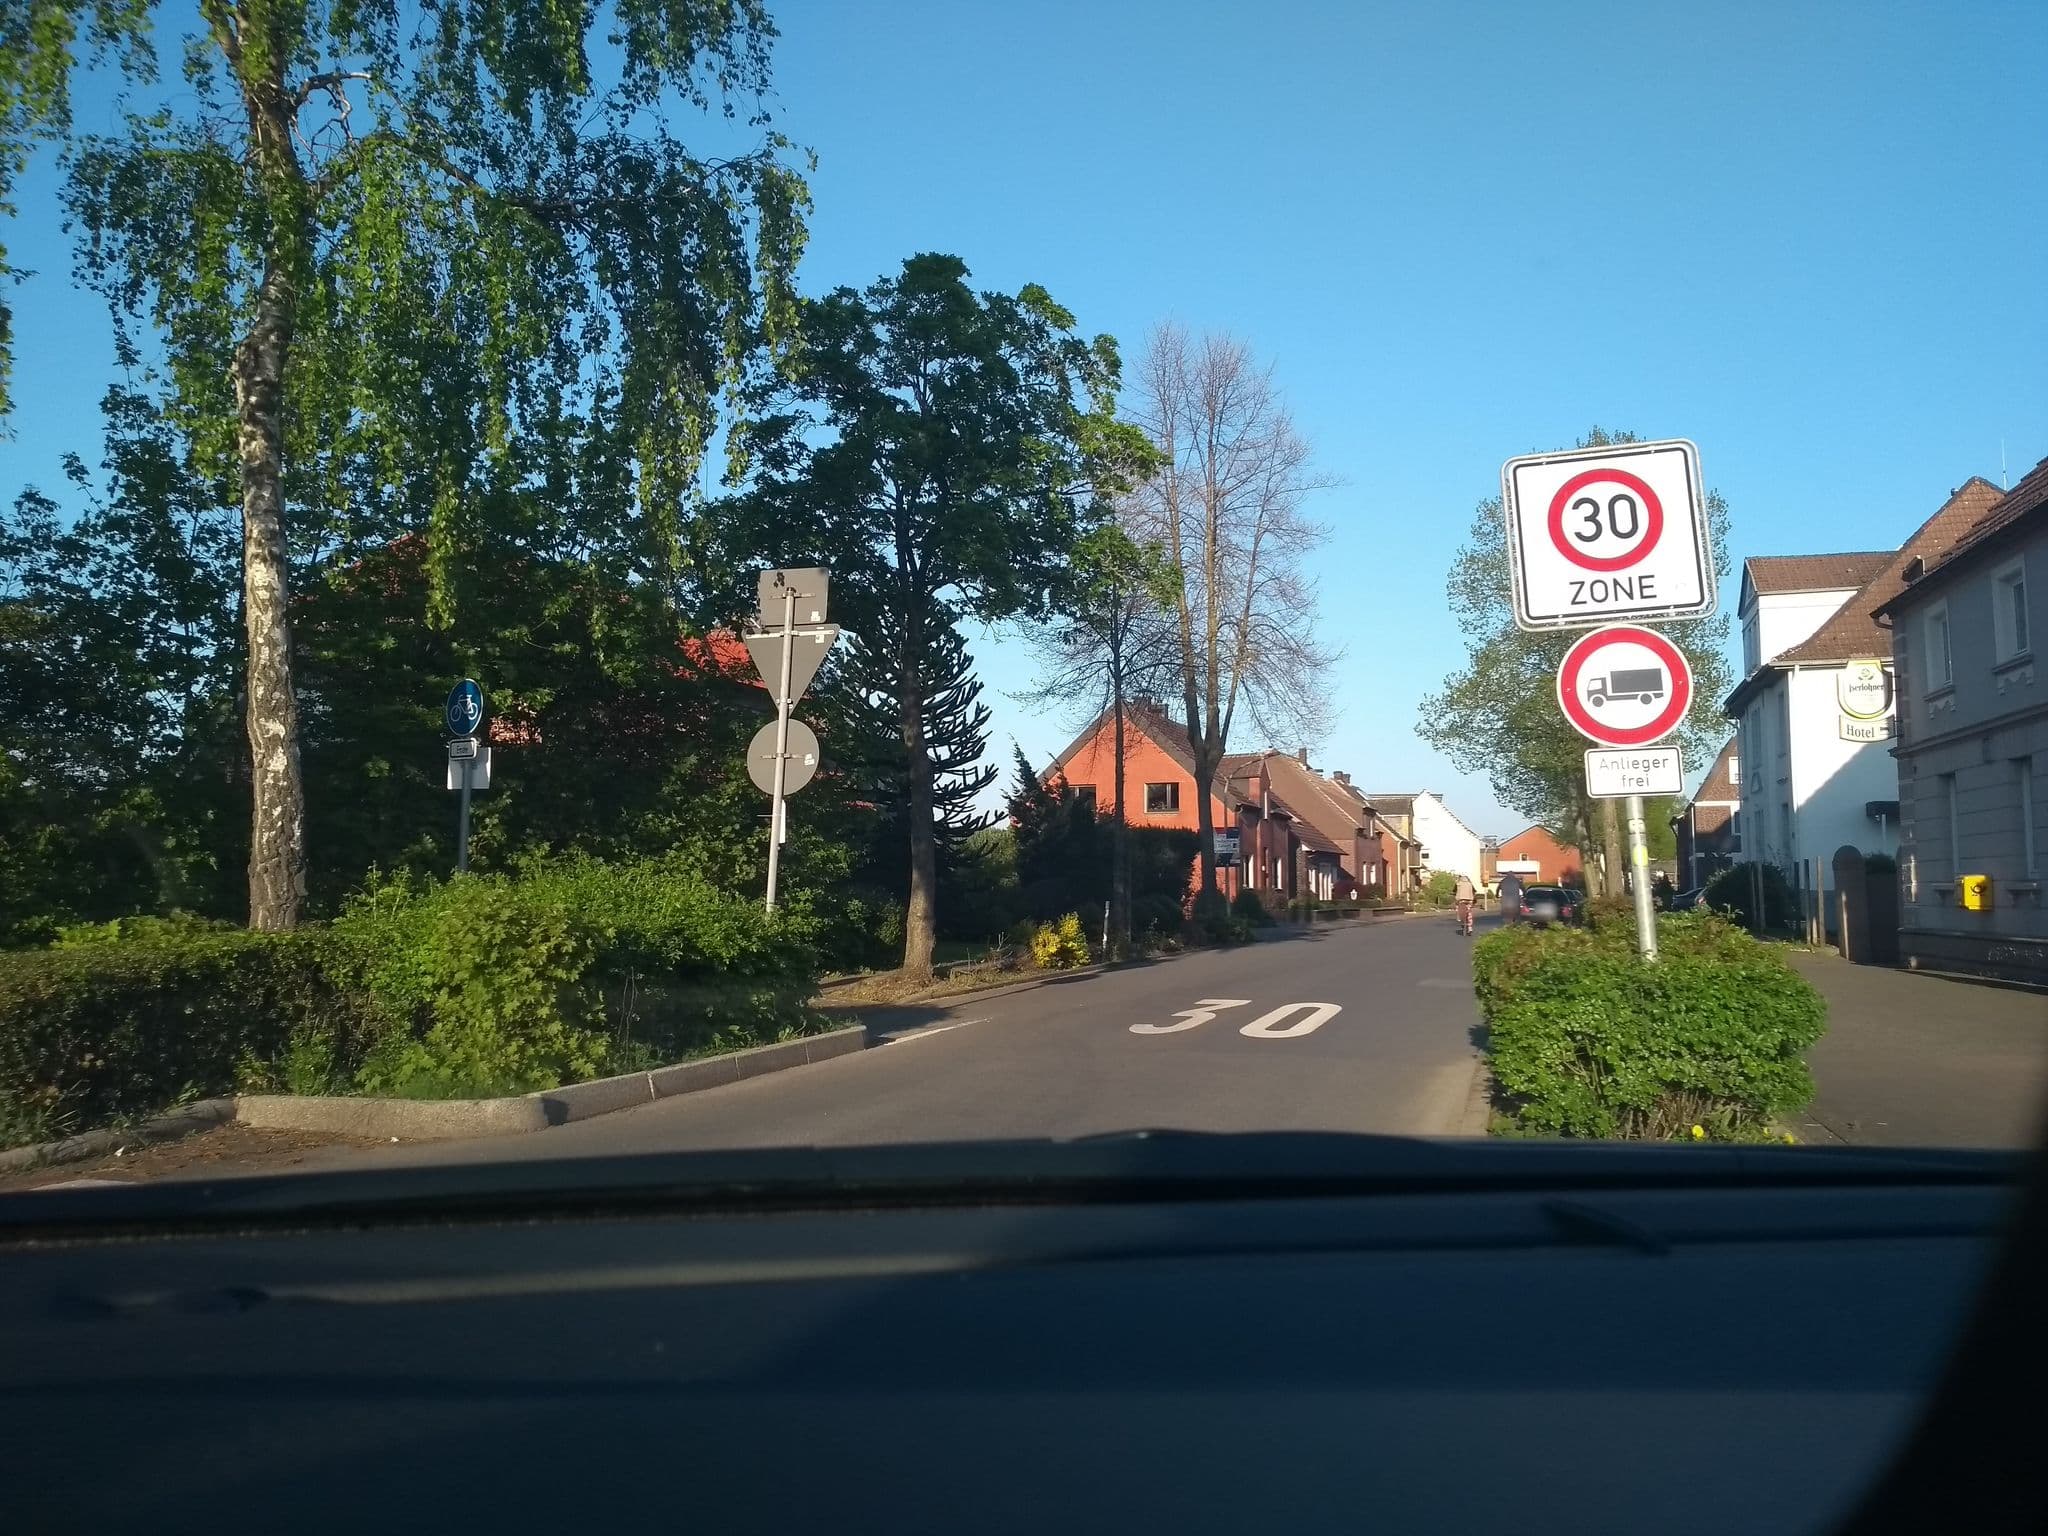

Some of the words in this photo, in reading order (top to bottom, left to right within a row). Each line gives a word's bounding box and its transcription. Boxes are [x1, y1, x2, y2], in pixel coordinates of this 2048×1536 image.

[1571, 494, 1639, 543] 30
[1569, 574, 1658, 606] ZONE
[1846, 724, 1876, 738] Hotel
[1600, 757, 1669, 773] Anlieger
[1621, 774, 1650, 787] frei
[1129, 999, 1342, 1038] 30
